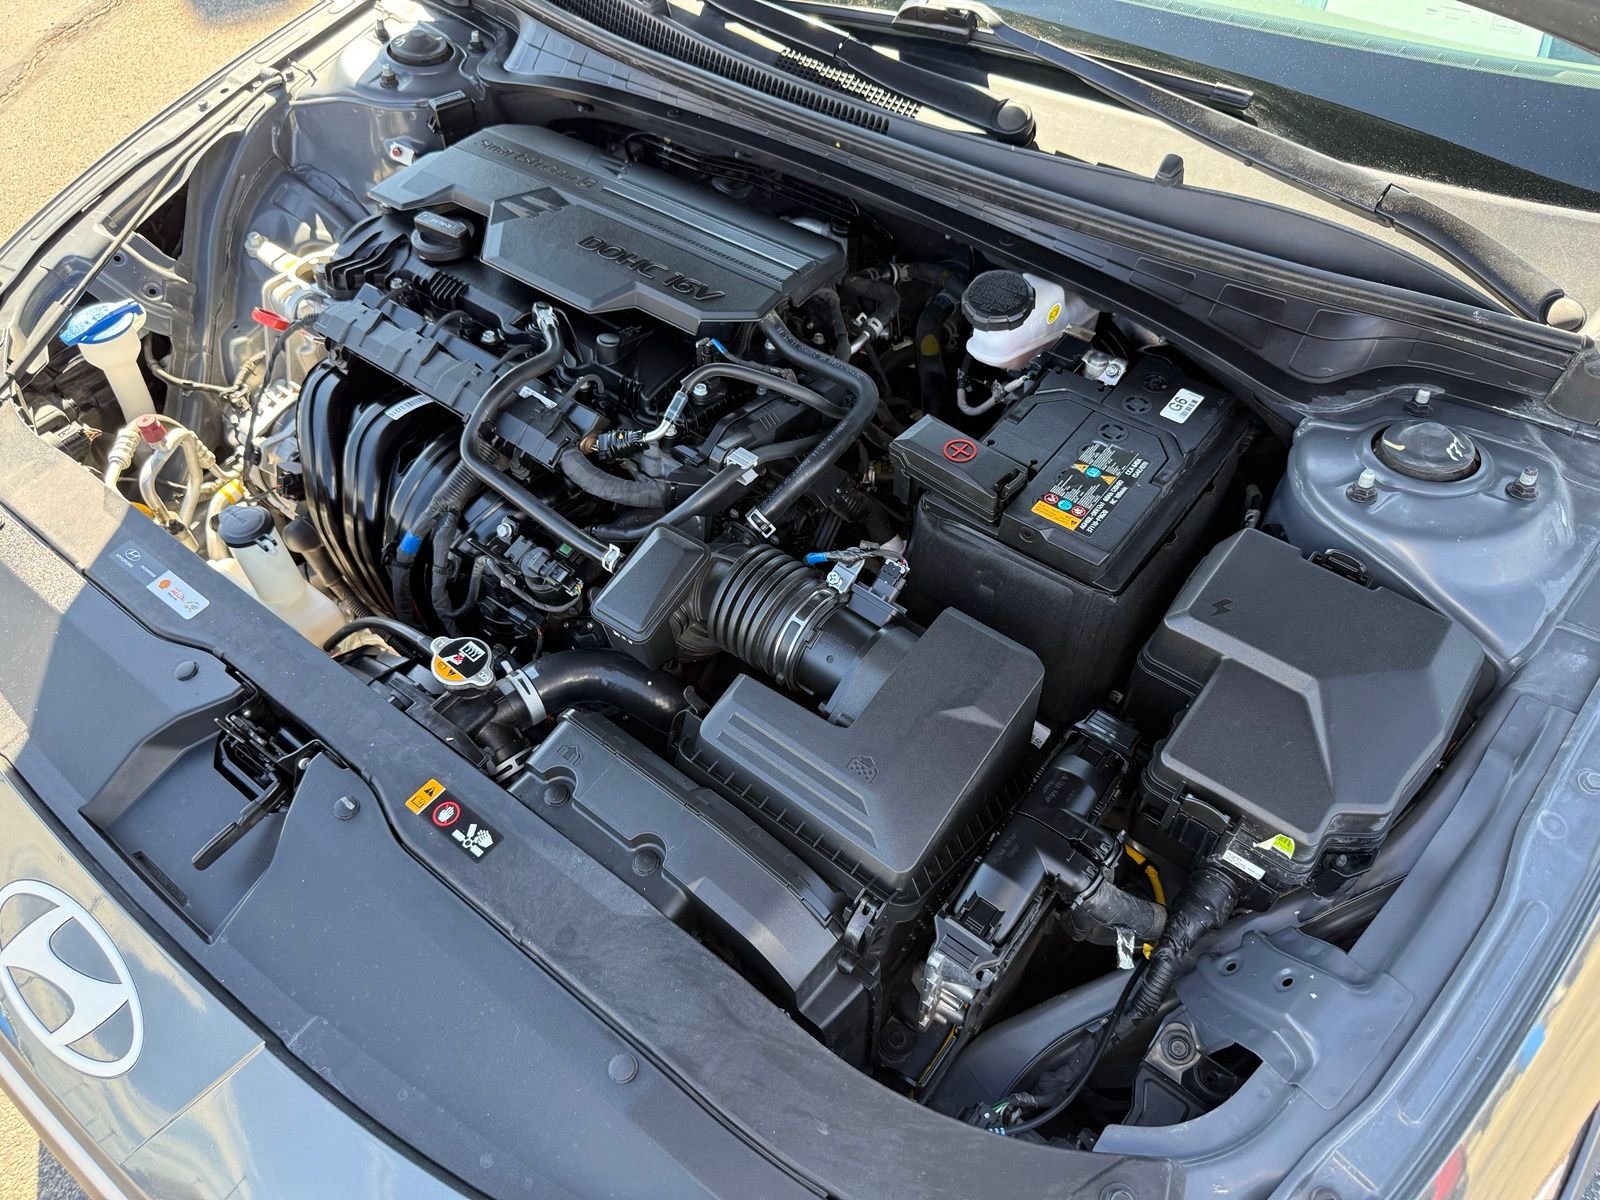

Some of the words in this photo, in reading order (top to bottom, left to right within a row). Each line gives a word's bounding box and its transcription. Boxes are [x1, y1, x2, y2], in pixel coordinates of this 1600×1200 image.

[576, 235, 669, 279] DOHC
[663, 271, 726, 301] 16V
[1169, 396, 1188, 412] G6
